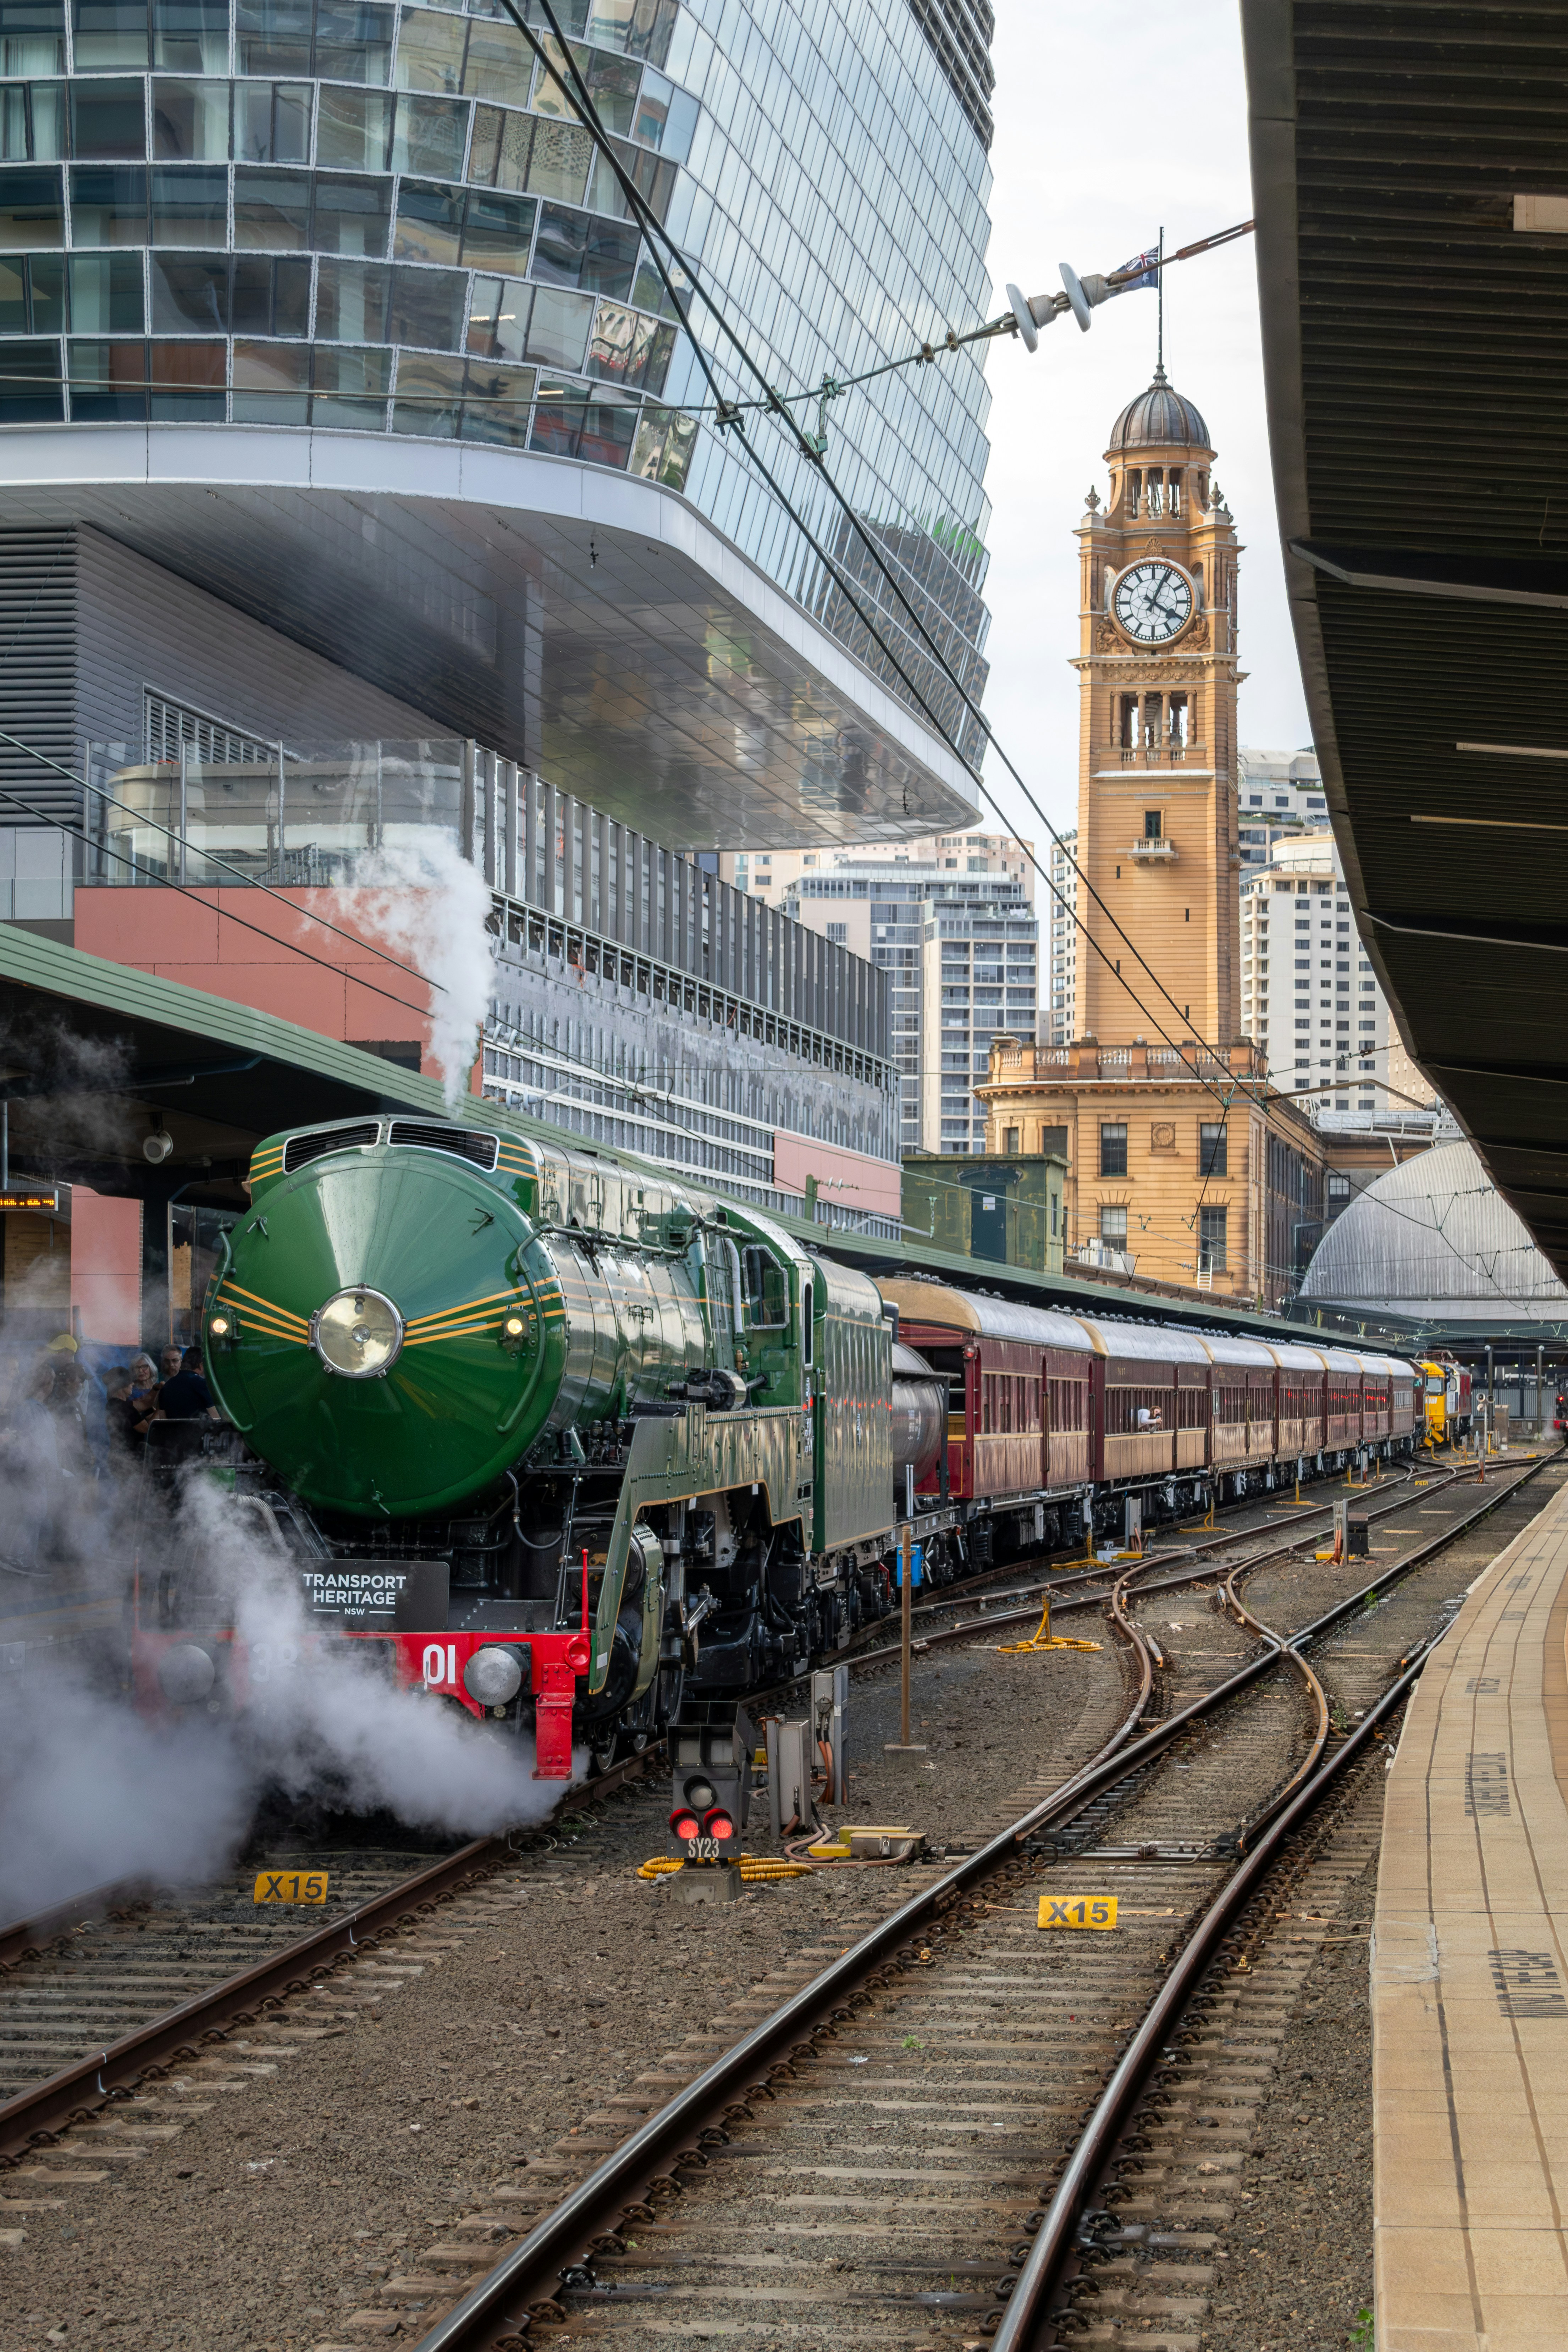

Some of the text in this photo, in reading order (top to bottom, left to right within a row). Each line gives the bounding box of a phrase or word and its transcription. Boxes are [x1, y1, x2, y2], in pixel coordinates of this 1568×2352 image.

[303, 1573, 407, 1589] TRANSPORT
[313, 1590, 396, 1605] HERITAGE
[423, 1644, 456, 1684] 01
[688, 1838, 719, 1857] SY23
[264, 1876, 322, 1899] X15
[1047, 1901, 1109, 1923] X15
[1487, 1949, 1555, 1970] GAP
[1492, 1971, 1562, 1990] THE
